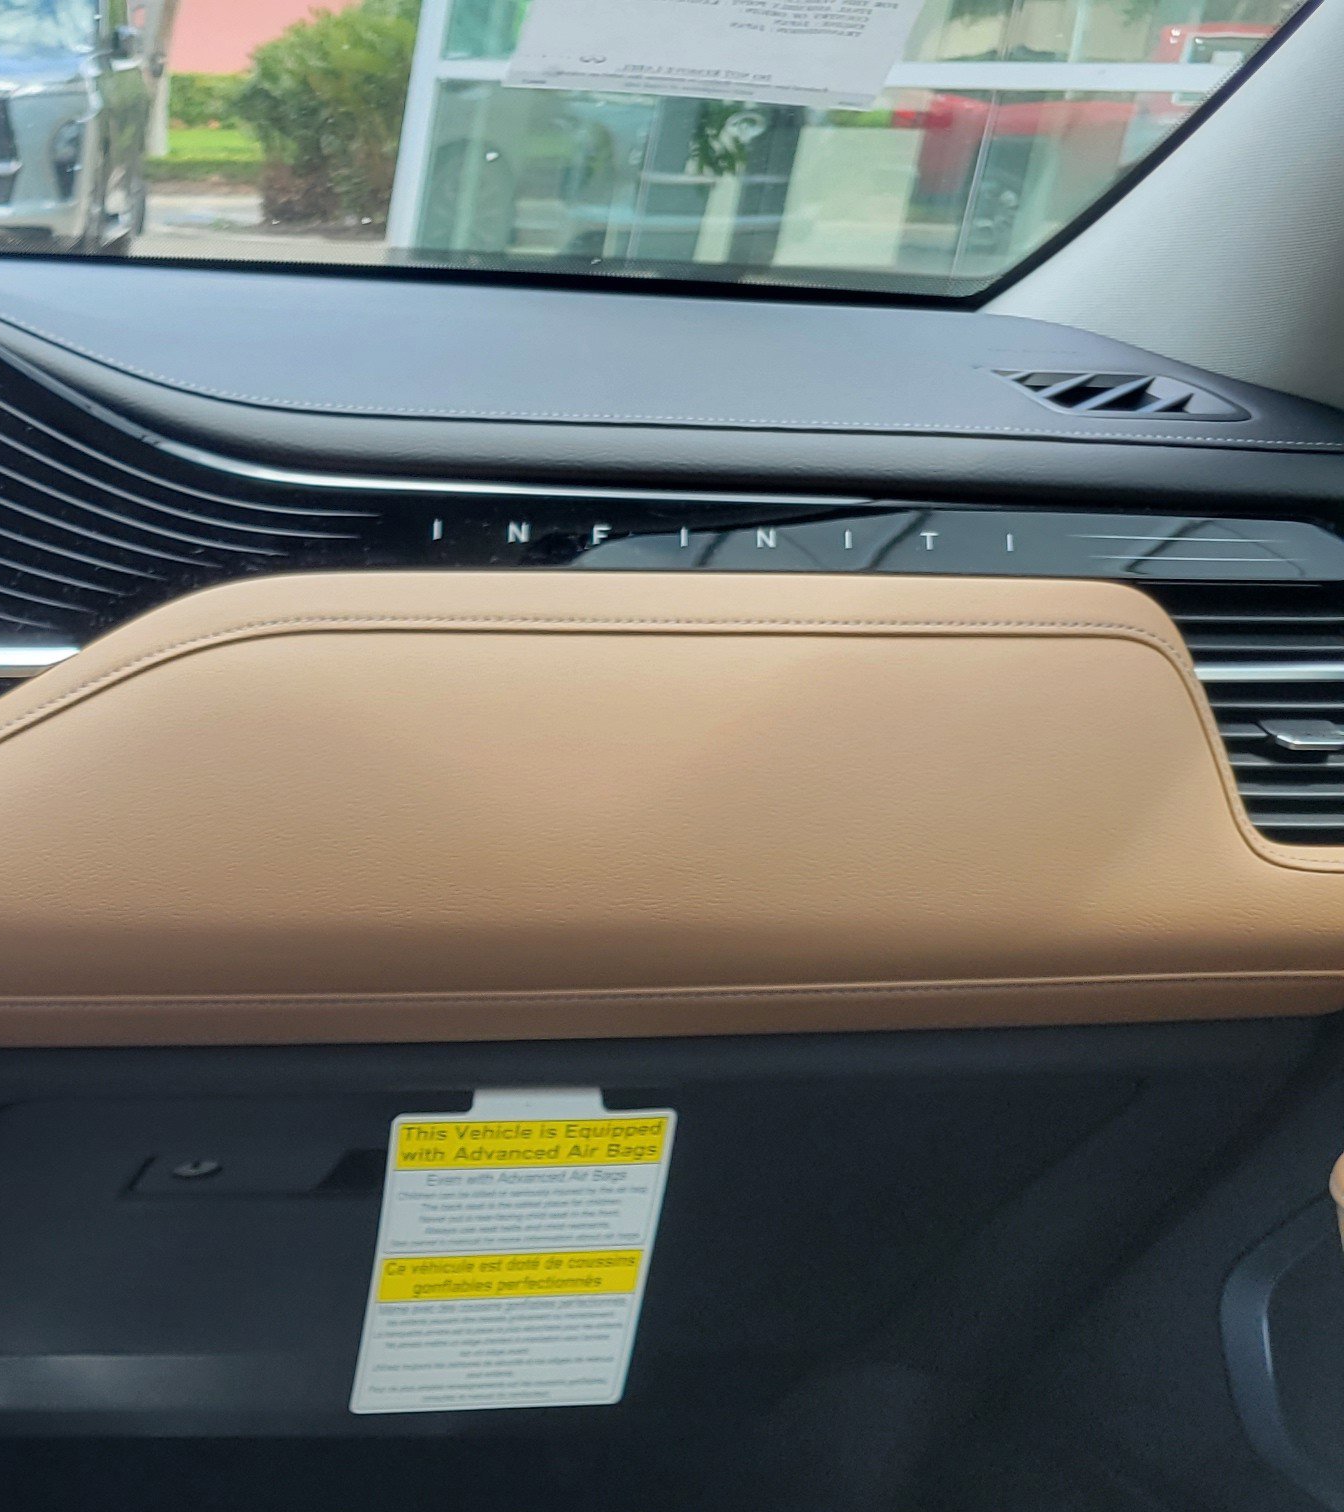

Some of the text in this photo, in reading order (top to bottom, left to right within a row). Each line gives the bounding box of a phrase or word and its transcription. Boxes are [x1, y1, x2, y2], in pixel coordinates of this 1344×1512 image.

[431, 517, 1014, 552] INFINITI
[402, 1121, 662, 1141] This Vehicle is Equipped
[401, 1143, 657, 1162] with Advanced Air Bags
[386, 1262, 406, 1276] Ce
[478, 1260, 503, 1273] est
[543, 1257, 563, 1270] de
[568, 1256, 636, 1269] coussins
